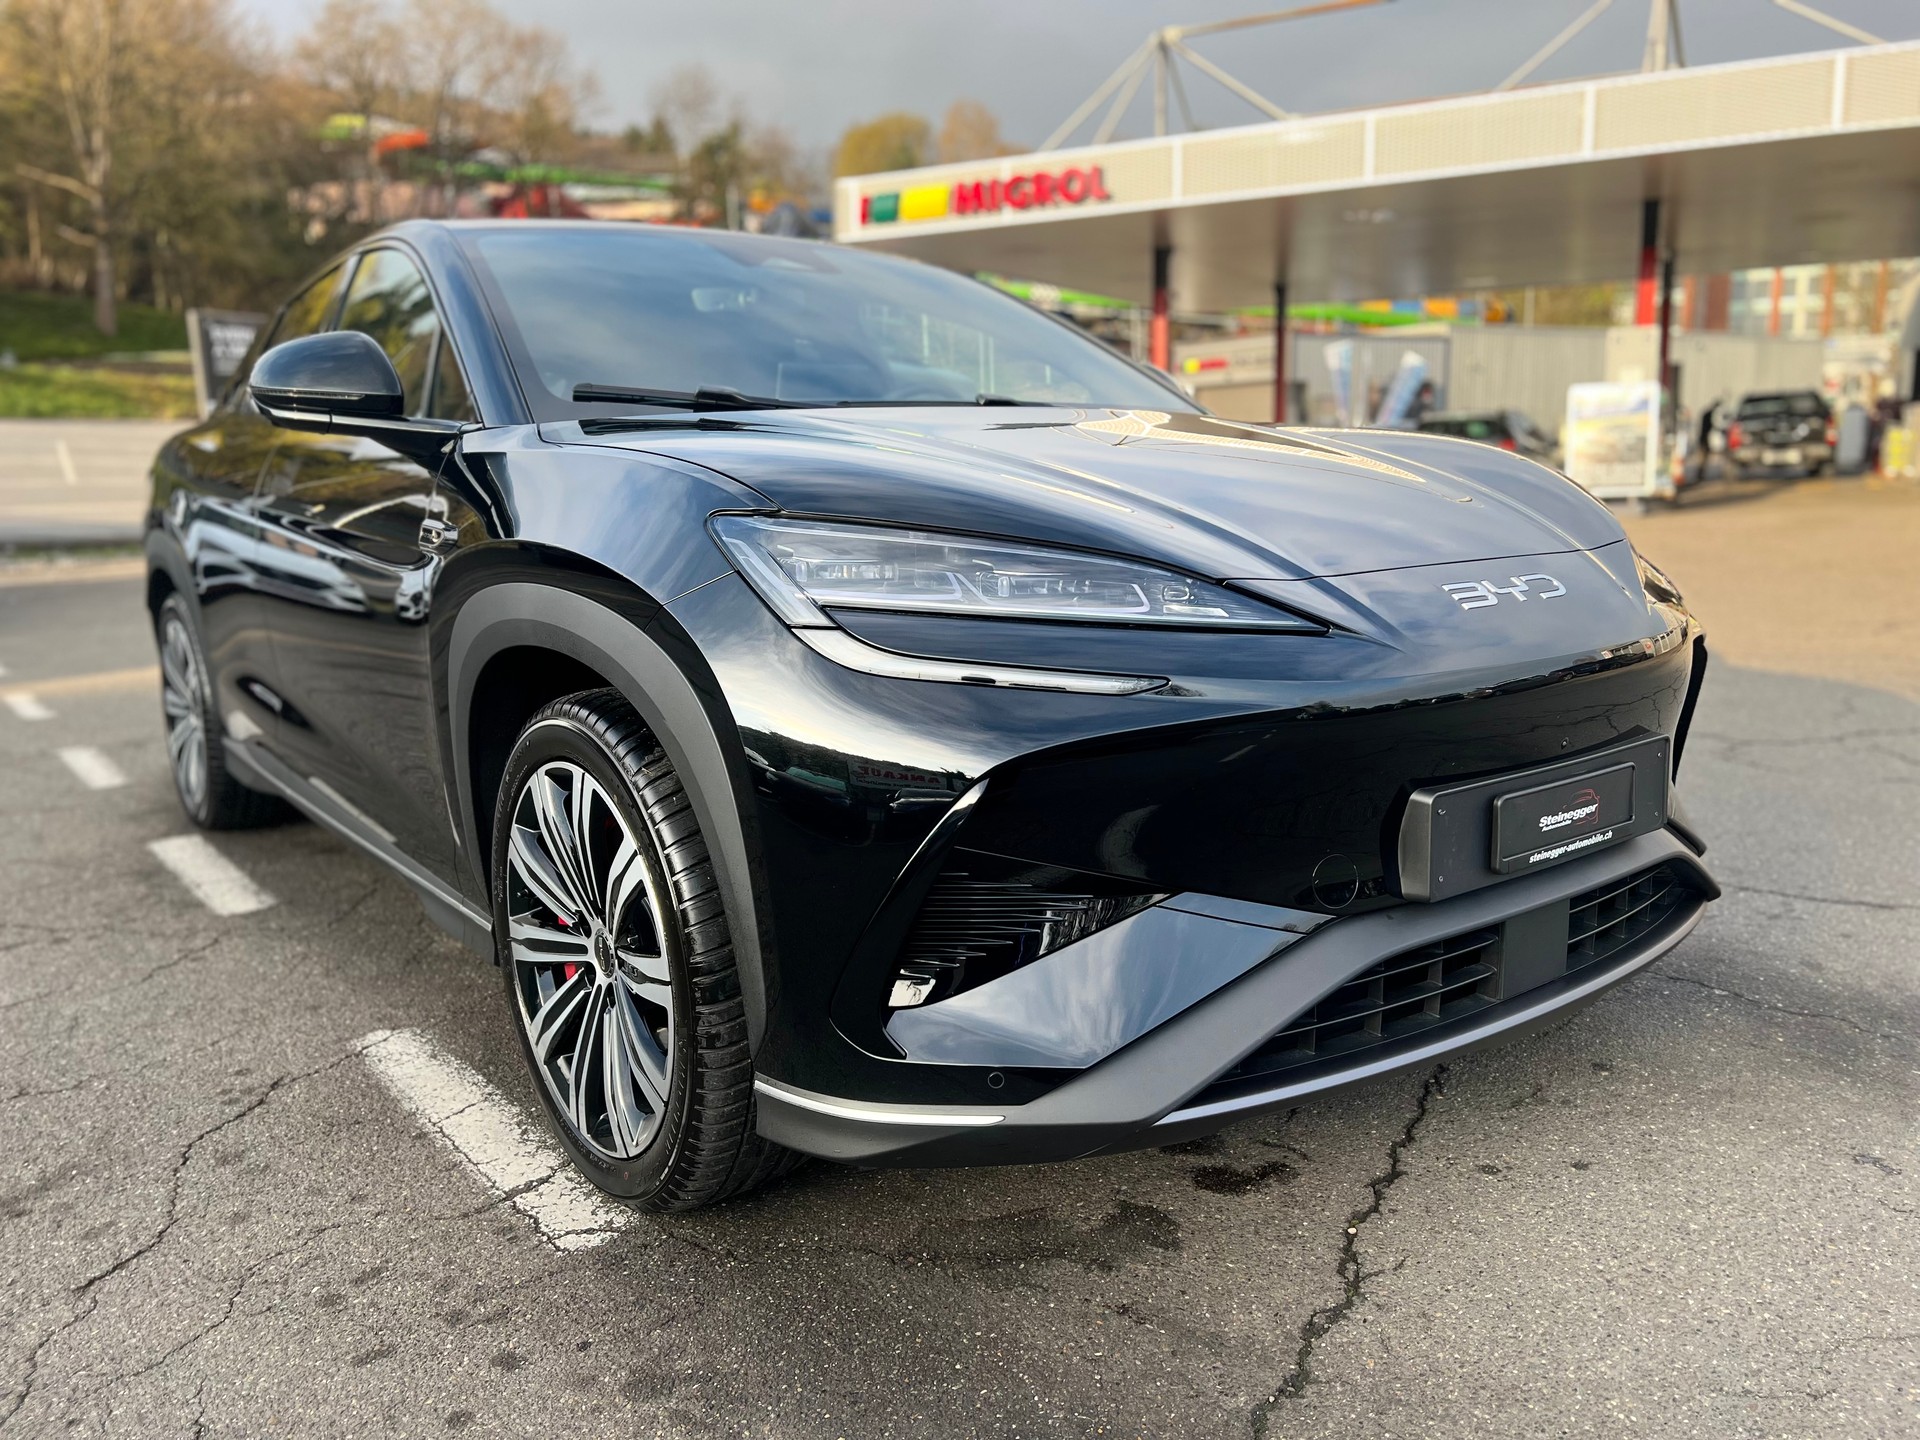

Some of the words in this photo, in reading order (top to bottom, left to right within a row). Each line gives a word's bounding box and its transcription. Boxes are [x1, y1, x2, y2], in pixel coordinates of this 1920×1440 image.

[952, 165, 1110, 215] MIGROL
[1441, 573, 1567, 611] BYD
[1539, 803, 1599, 827] Steinegger
[1529, 830, 1613, 863] steinegger-automobile.ch
